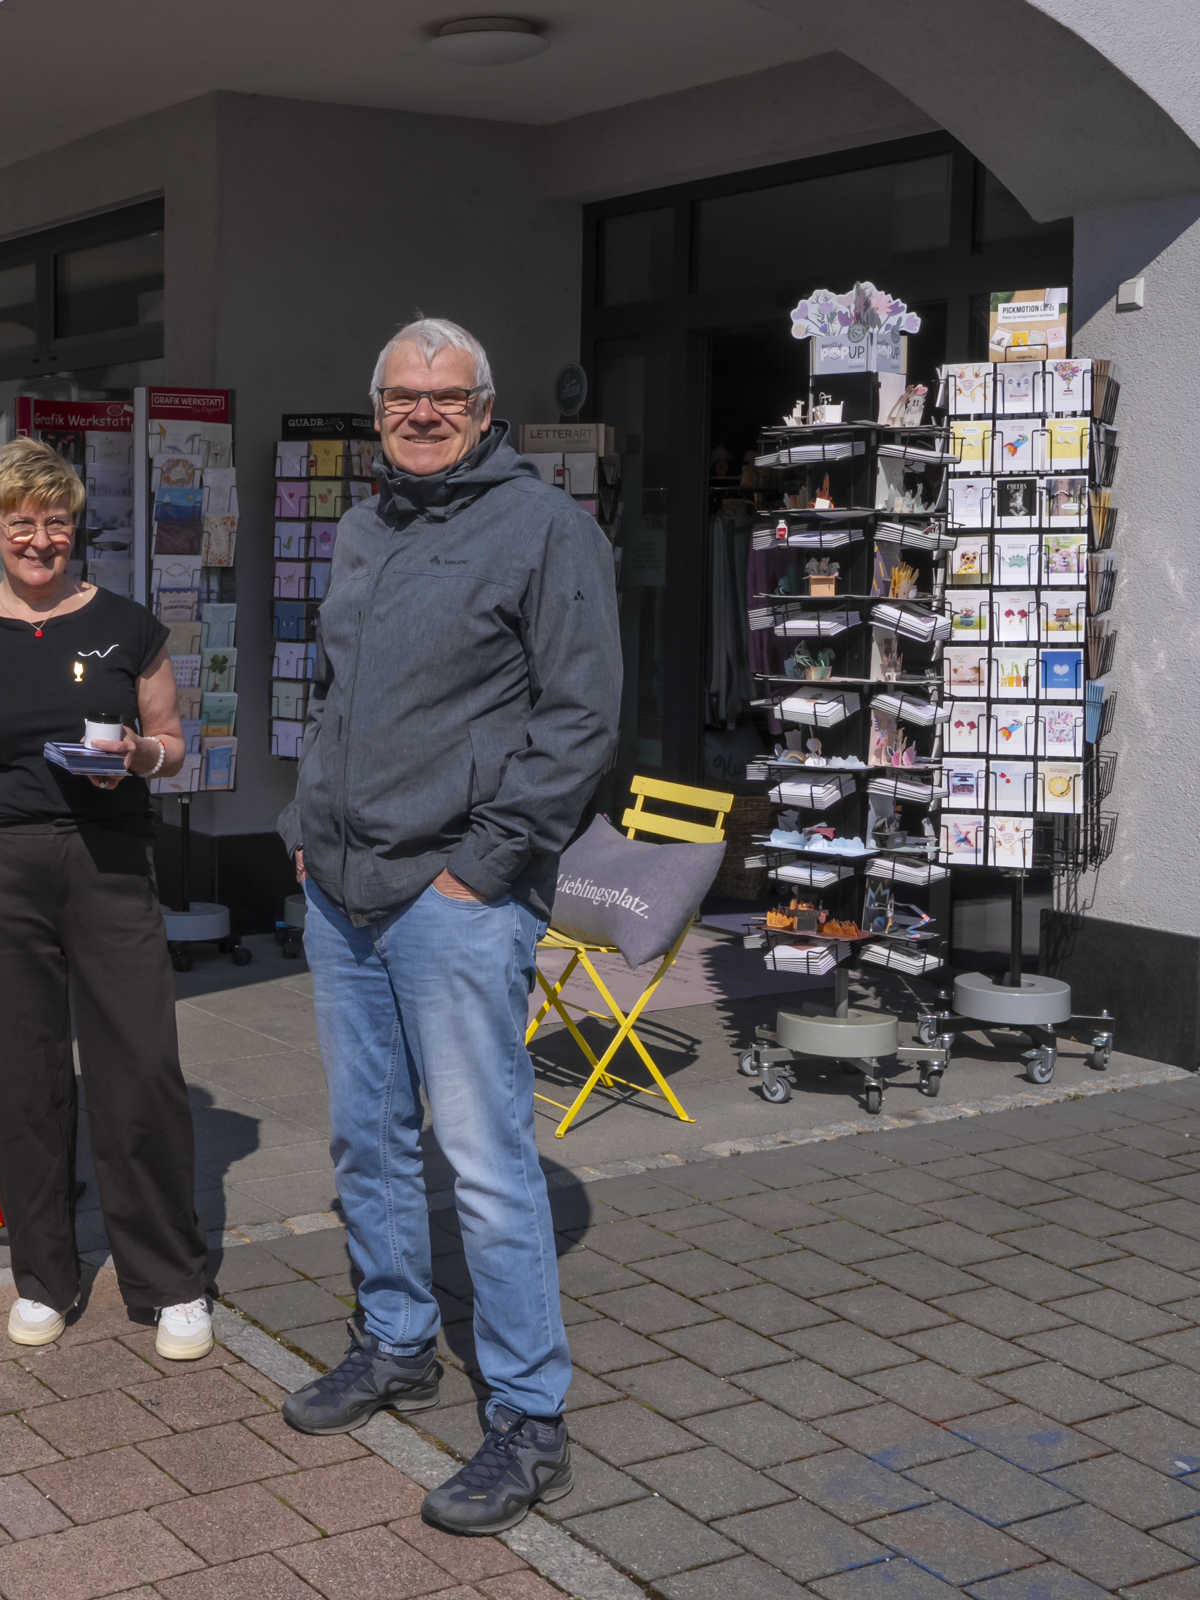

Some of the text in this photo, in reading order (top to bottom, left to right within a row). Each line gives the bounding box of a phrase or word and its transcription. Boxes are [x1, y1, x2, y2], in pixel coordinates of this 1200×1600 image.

[1002, 305, 1040, 314] PICKMOTION
[181, 396, 223, 407] WERKSTATT
[34, 412, 132, 427] Grafik Werkstatt
[530, 428, 594, 440] LETTERART
[556, 873, 650, 920] Lieblingsplatz.
